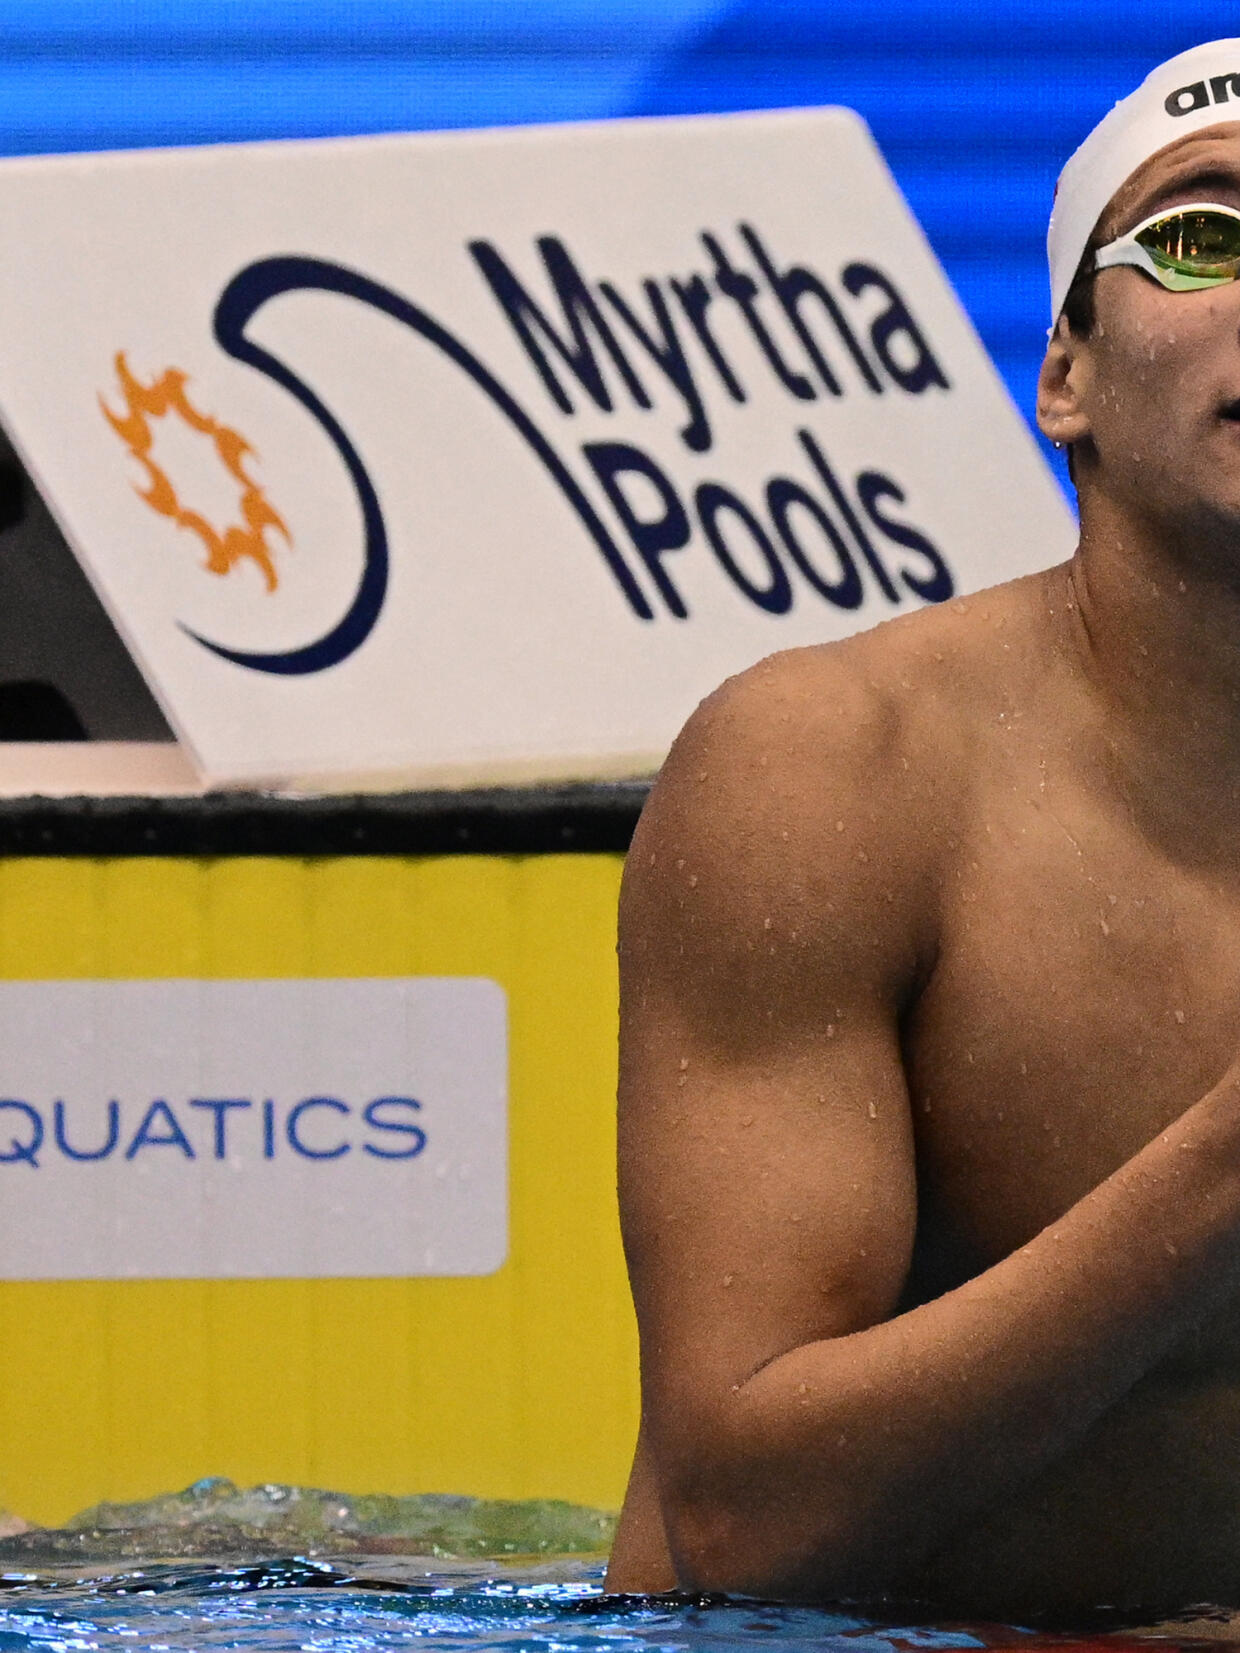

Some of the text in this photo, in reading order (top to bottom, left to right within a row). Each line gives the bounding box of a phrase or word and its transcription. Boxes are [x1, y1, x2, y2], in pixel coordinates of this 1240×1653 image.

[467, 223, 951, 453] Myrtha
[582, 428, 955, 620] Pools
[0, 1095, 428, 1169] QUATICS
